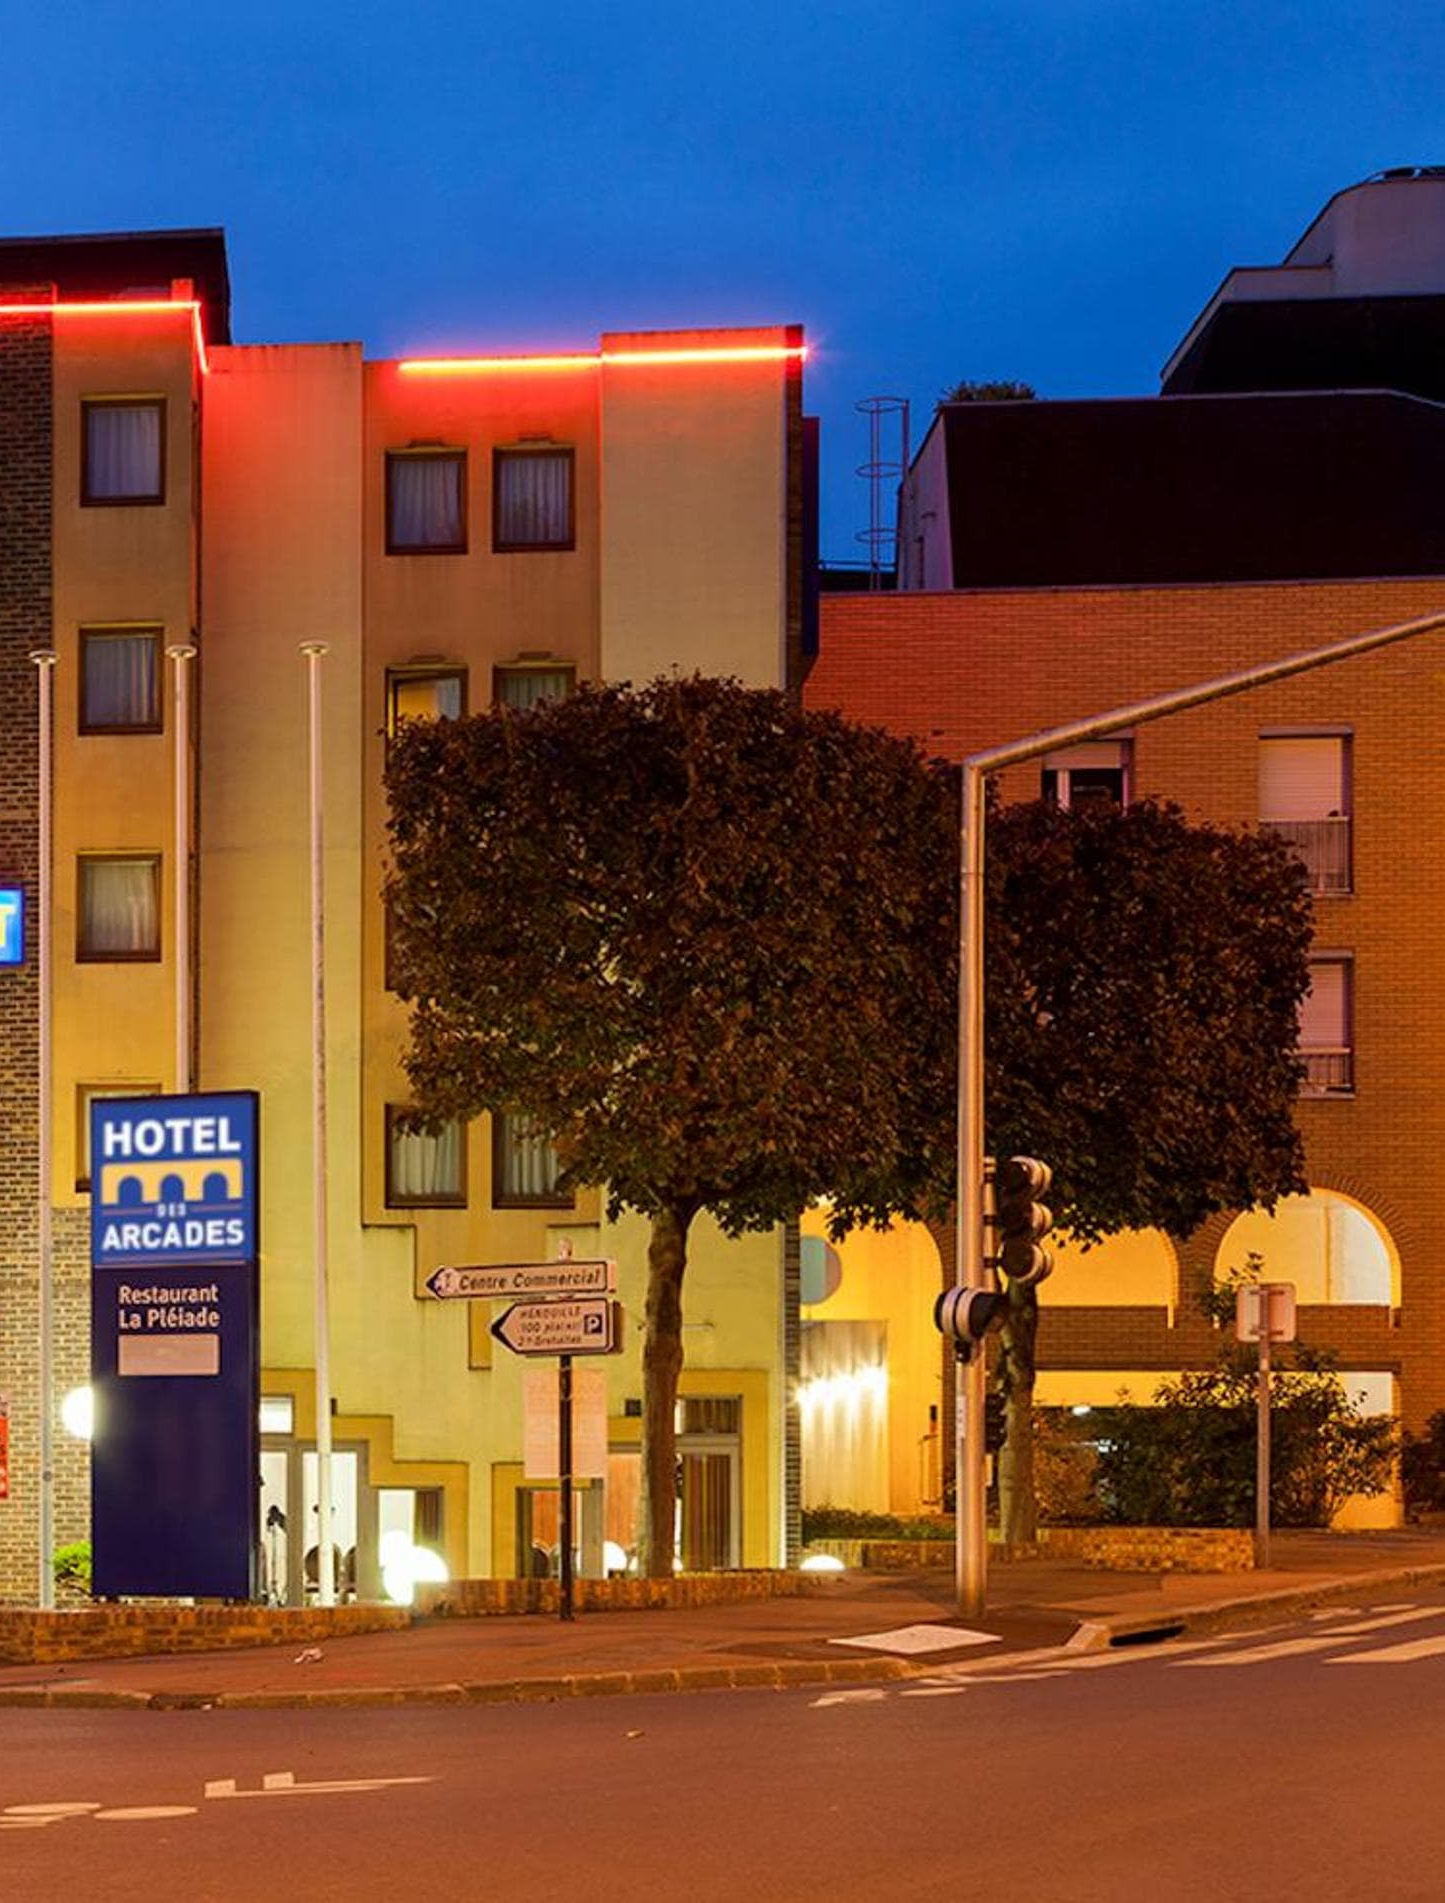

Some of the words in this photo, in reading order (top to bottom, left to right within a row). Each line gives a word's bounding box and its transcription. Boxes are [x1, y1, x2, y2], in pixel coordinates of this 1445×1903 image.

[103, 1117, 241, 1157] HOTEL
[157, 1202, 187, 1218] DES
[102, 1219, 244, 1250] ARCADES
[459, 1273, 506, 1291] Centre
[513, 1269, 601, 1288] Commercial
[118, 1283, 219, 1304] Restaurant
[118, 1309, 142, 1329] La
[147, 1306, 220, 1328] Pléiade
